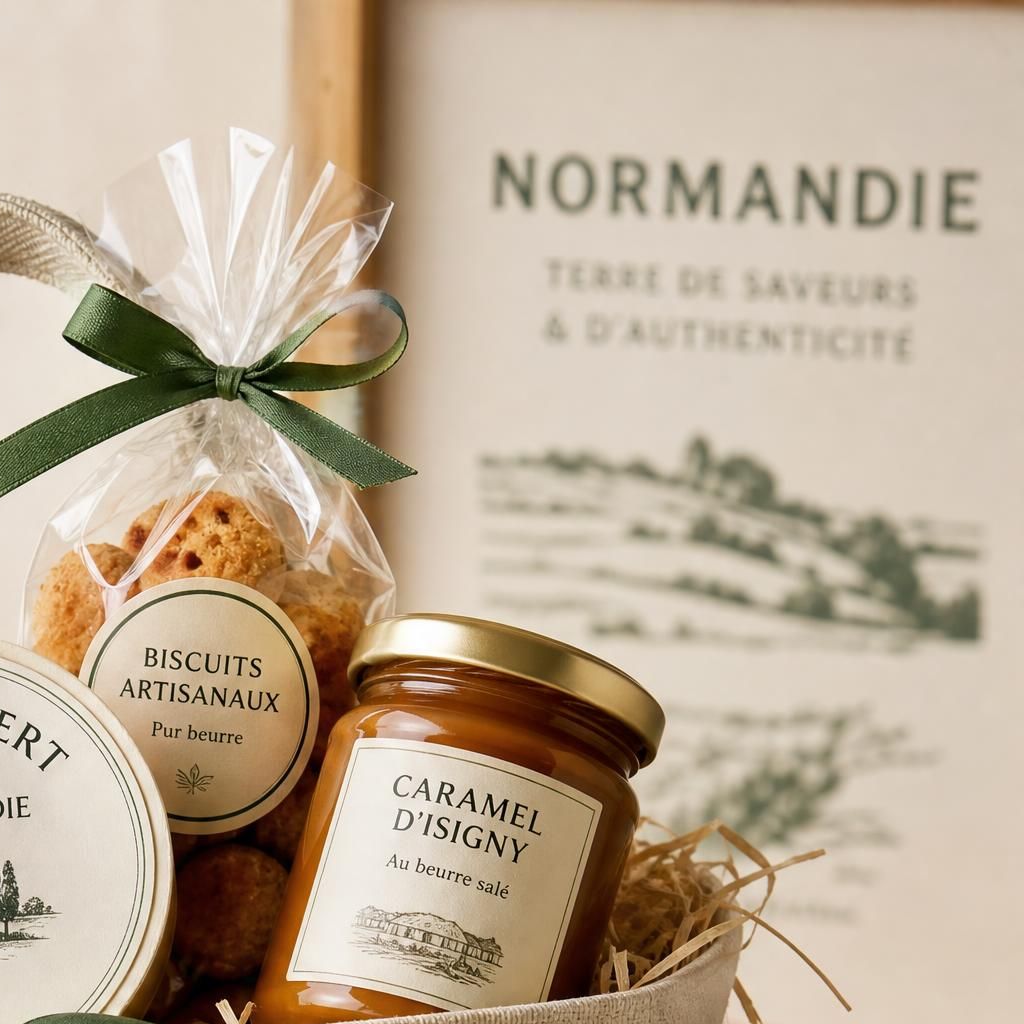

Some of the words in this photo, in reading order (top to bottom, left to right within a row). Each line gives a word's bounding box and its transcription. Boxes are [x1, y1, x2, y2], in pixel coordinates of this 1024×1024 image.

[491, 152, 981, 233] NORMANDIE
[545, 258, 660, 295] TERRE
[678, 266, 725, 299] DE
[744, 268, 917, 309] SAVEURS
[542, 311, 567, 344] &
[144, 647, 262, 678] BISCUITS
[119, 678, 280, 713] ARTISANAUX
[151, 721, 182, 739] Pur
[188, 725, 244, 745] beurre
[392, 775, 543, 836] CARAMEL
[385, 853, 409, 871] Au
[415, 858, 472, 887] beurre
[476, 878, 510, 900] salé
